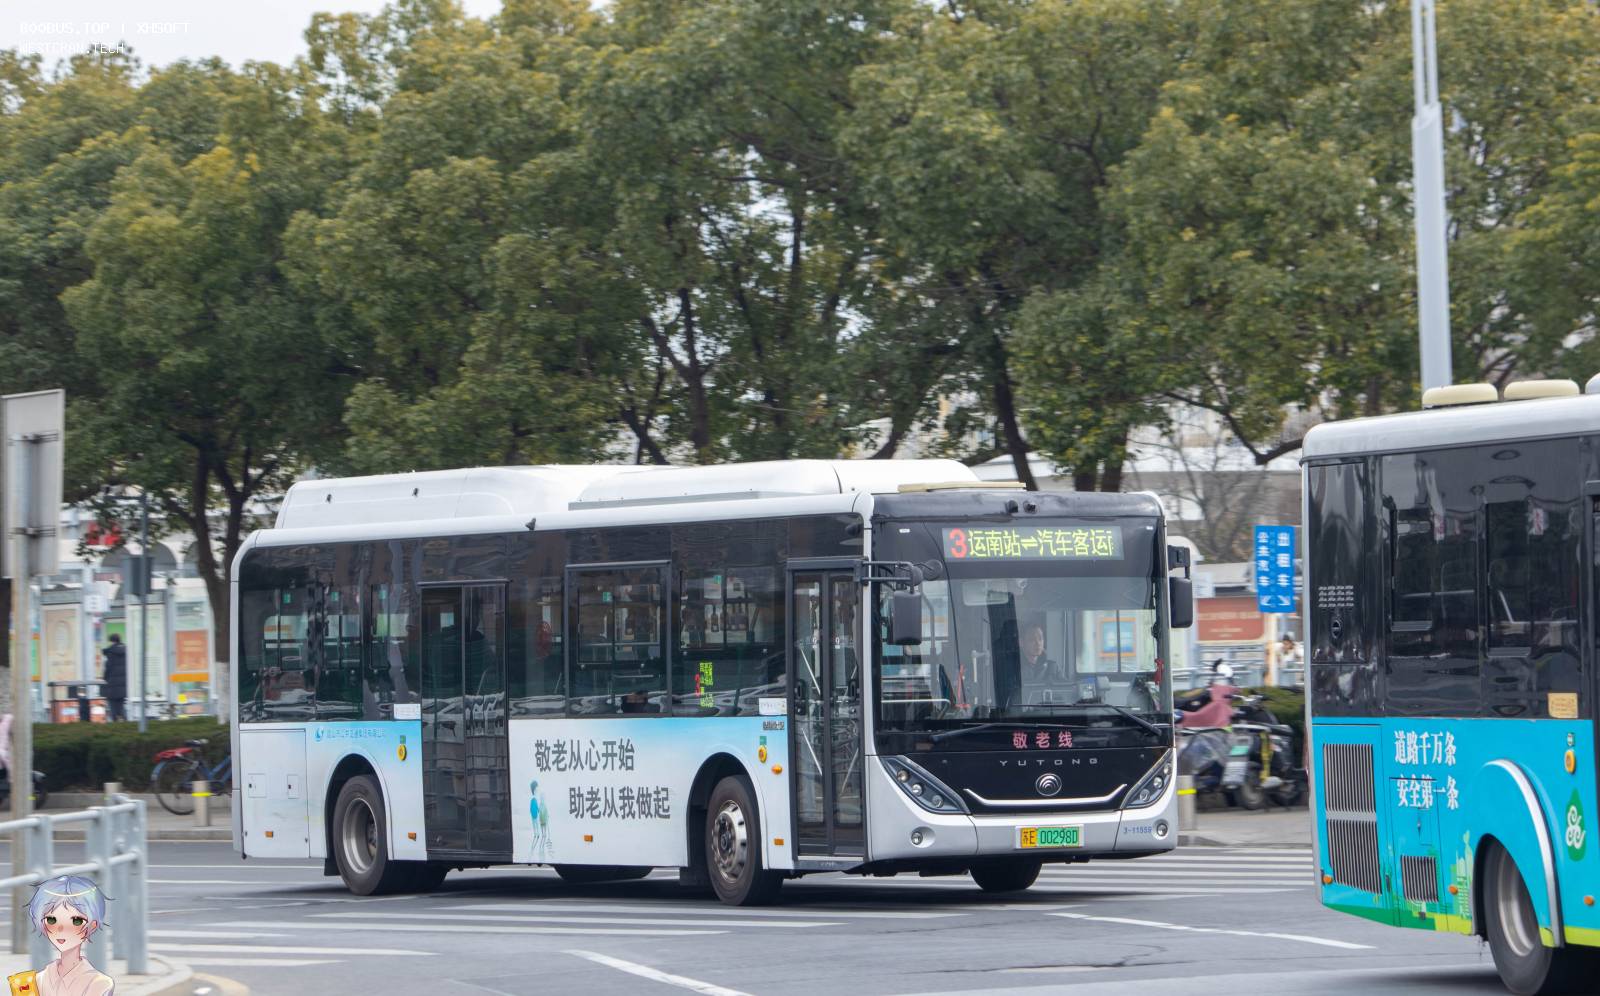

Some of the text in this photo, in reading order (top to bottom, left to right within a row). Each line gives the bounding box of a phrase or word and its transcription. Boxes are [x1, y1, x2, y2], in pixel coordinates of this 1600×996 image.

[968, 529, 1021, 557] 运南站
[534, 738, 635, 772] 敬老从心开始
[1013, 731, 1073, 749] 敬老线
[1394, 730, 1457, 766] 道路千万条
[999, 757, 1099, 767] YUTONG
[569, 786, 671, 820] 助老从我做起
[1397, 774, 1459, 810] 安全第一条
